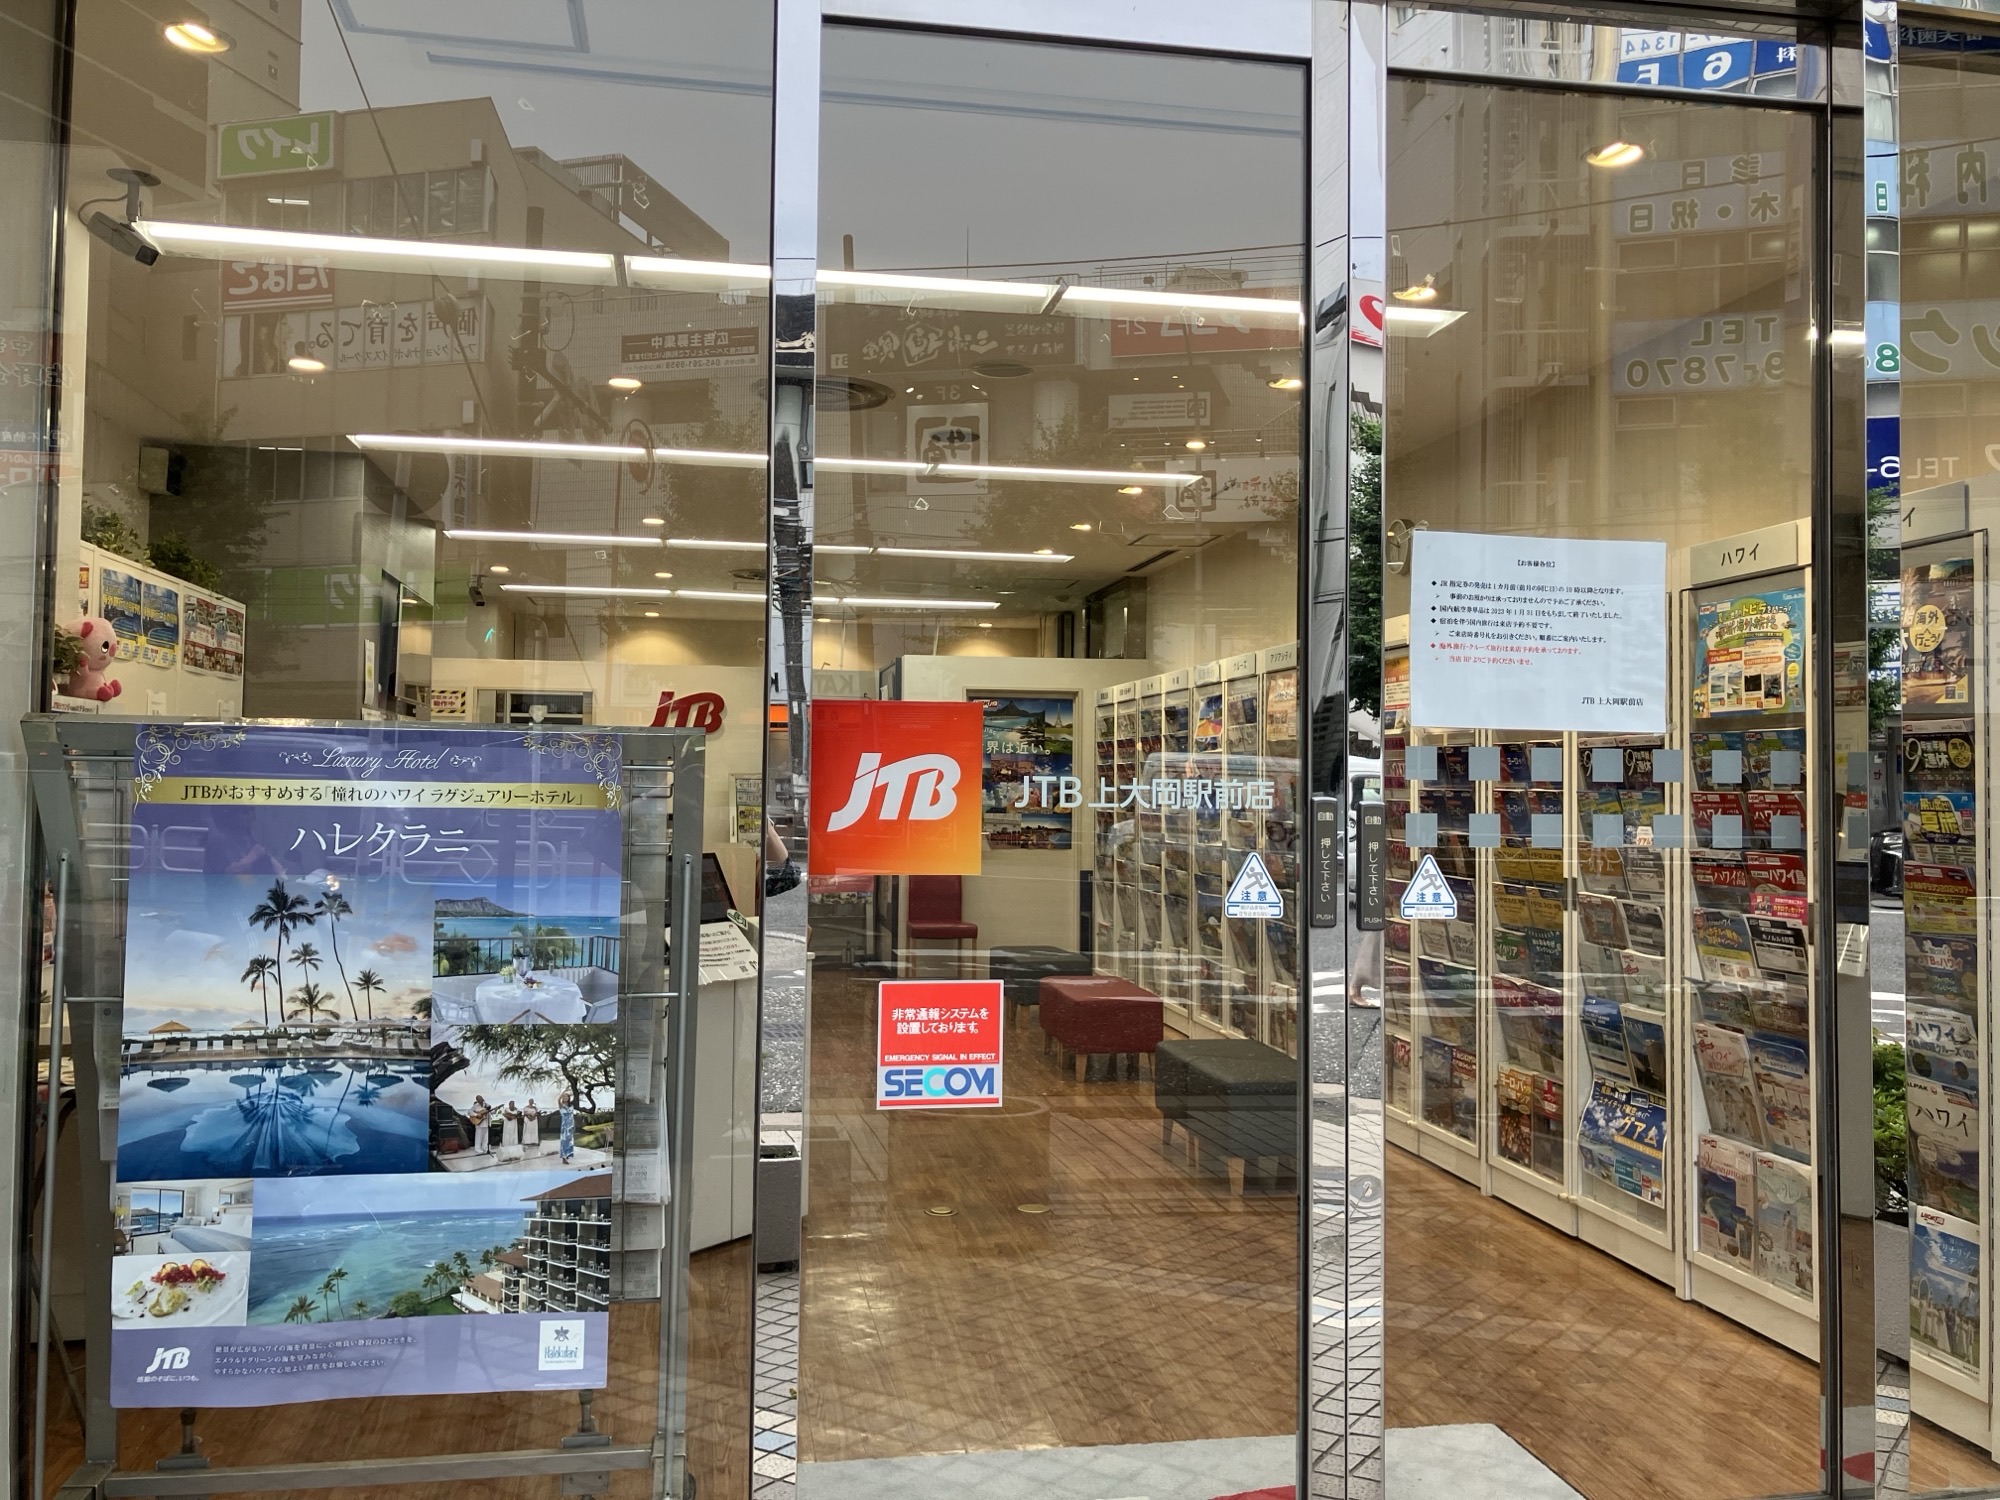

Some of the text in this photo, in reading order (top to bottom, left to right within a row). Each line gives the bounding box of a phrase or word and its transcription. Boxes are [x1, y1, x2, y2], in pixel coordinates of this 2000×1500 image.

[1721, 543, 1759, 566] ハワイ
[1916, 609, 1940, 625] 海外
[650, 691, 725, 733] JTB
[982, 740, 1051, 756] 界は近い。
[313, 746, 450, 779] Luxury Hotel
[827, 752, 962, 833] JTB
[1317, 811, 1334, 822] 自動
[1365, 815, 1382, 825] 自動
[290, 821, 470, 857] ハレクラニ
[1320, 837, 1332, 903] 押して下さい
[1368, 841, 1379, 906] 押して下さい
[1241, 891, 1268, 901] 注意
[1416, 892, 1442, 902] 注意
[892, 1008, 989, 1021] 非常通報システムを
[897, 1021, 979, 1035] 設置しております。
[884, 1054, 930, 1062] EMERGENCY
[884, 1067, 995, 1097] SECOM
[1915, 1105, 1968, 1137] ハワイ
[145, 1347, 191, 1374] JTB
